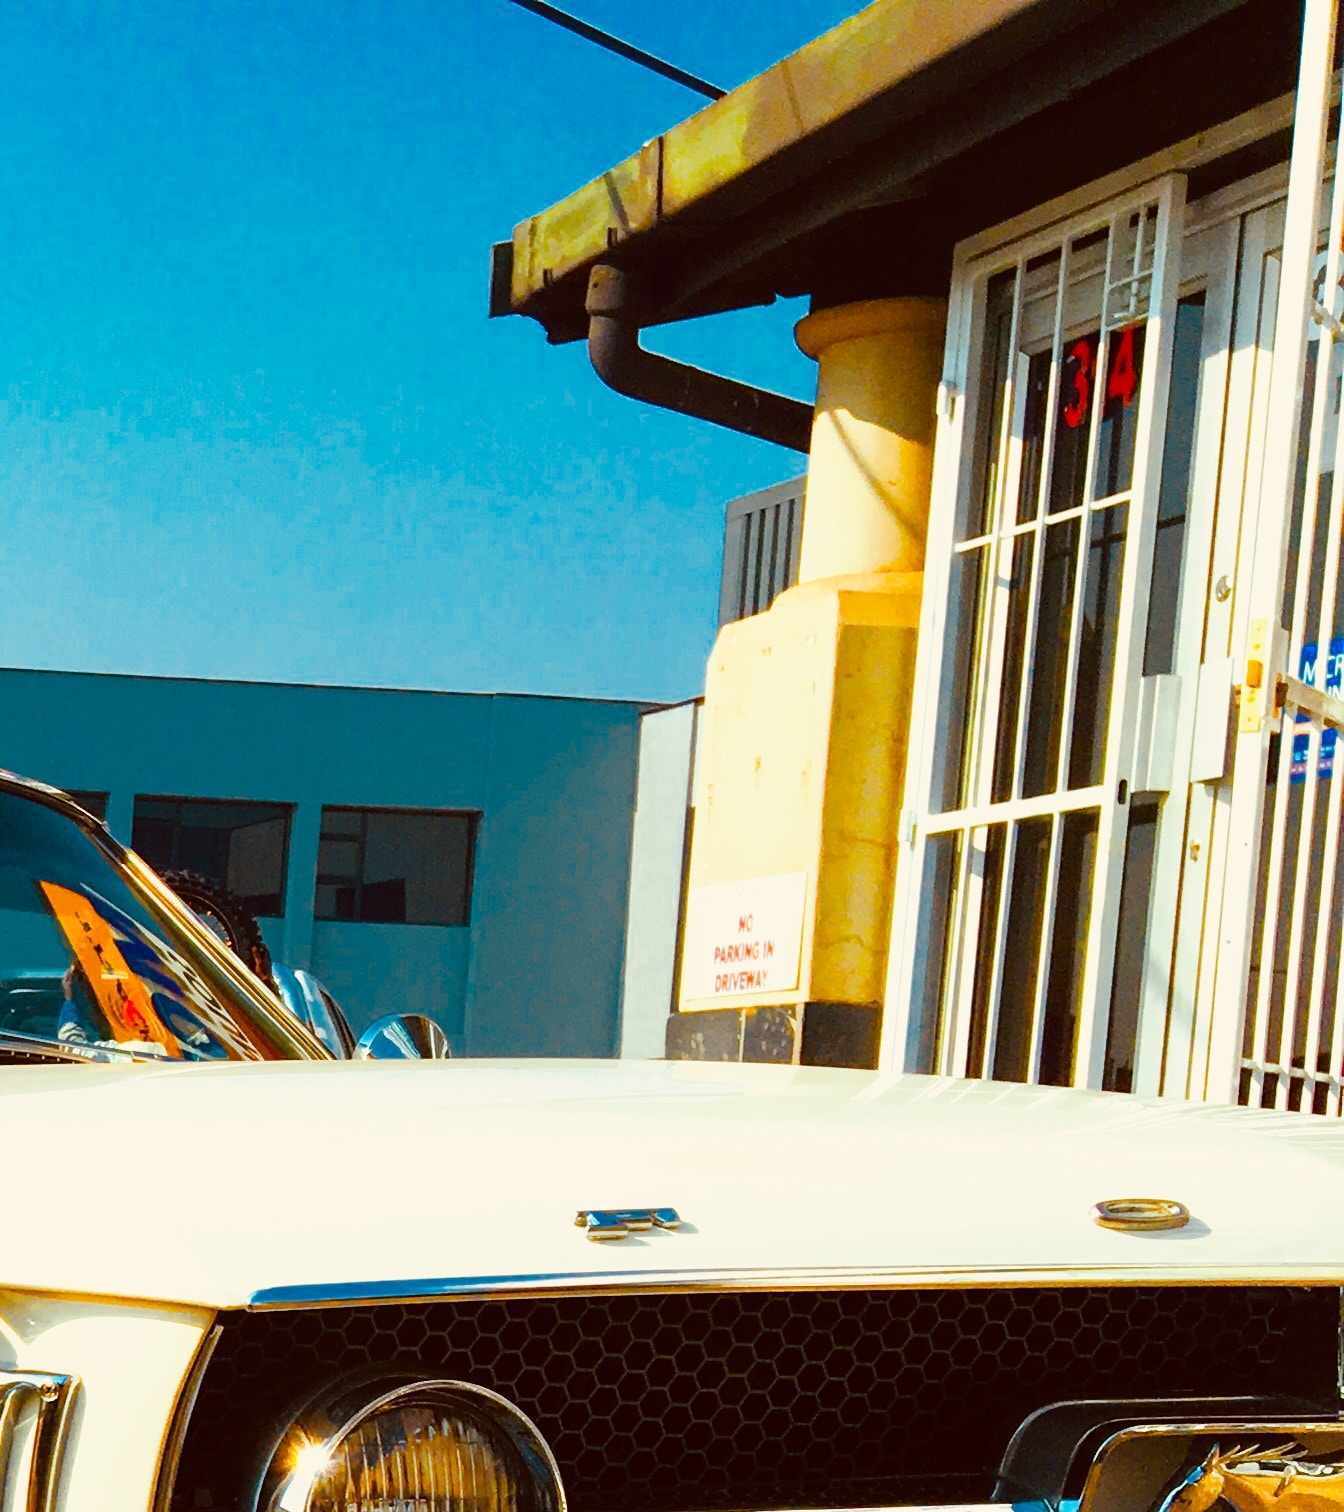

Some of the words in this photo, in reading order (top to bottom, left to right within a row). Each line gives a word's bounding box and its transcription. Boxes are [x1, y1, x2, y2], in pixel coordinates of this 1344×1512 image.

[738, 913, 753, 933] NO
[714, 941, 760, 964] PARKING
[763, 940, 775, 958] IN
[715, 969, 768, 992] DRIVEWAY
